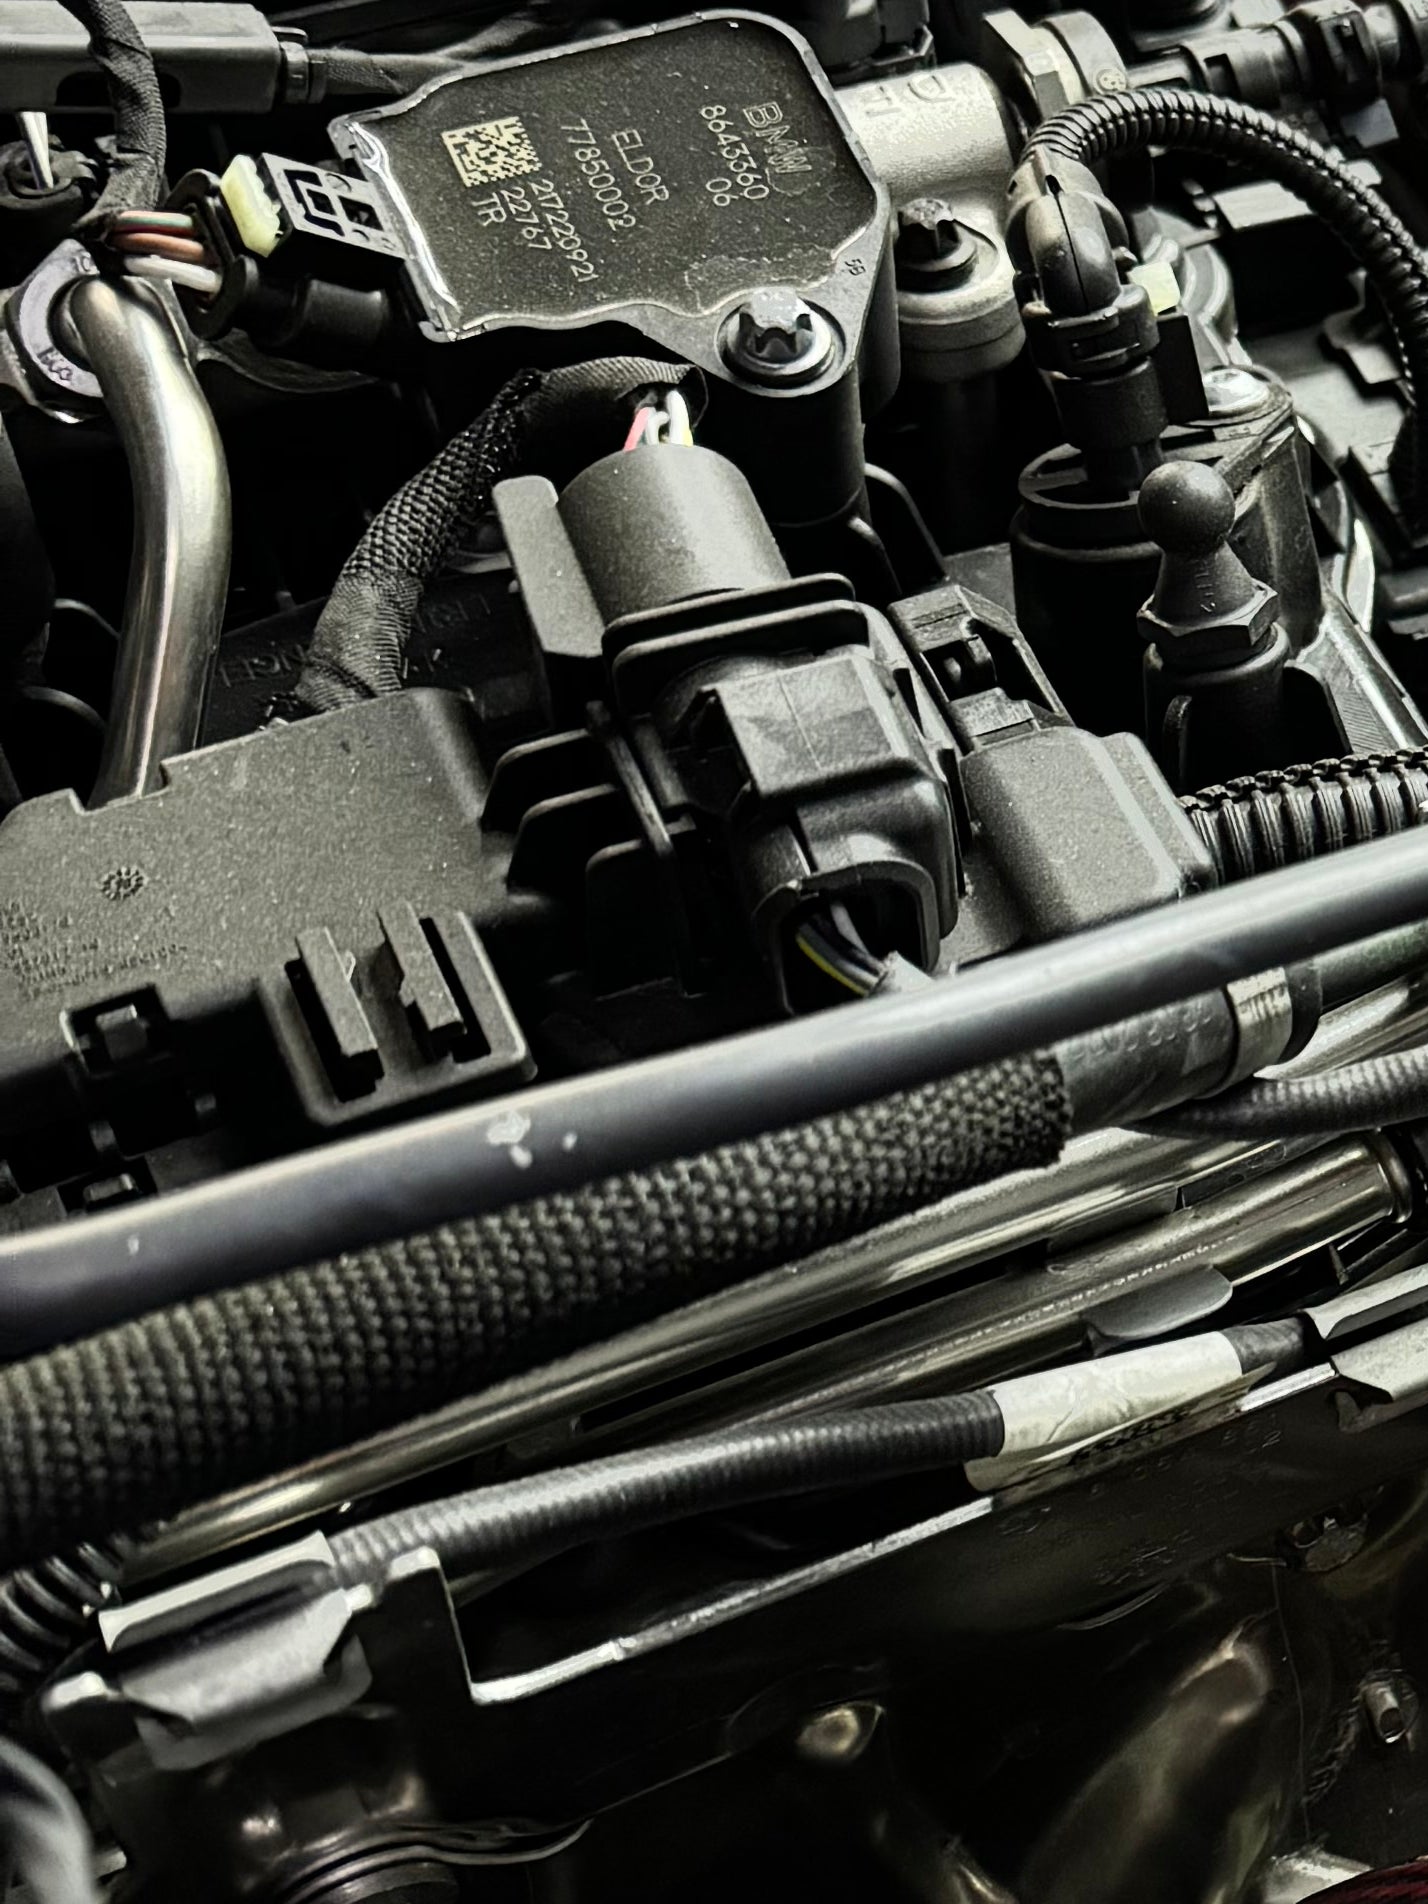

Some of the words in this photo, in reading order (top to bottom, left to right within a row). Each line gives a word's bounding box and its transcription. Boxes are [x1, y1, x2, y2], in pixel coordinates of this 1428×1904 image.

[560, 118, 637, 232] 77850002
[611, 128, 670, 205] ELDOR
[700, 103, 770, 201] 8643360
[742, 100, 813, 175] BMW
[471, 192, 507, 227] TR
[499, 185, 553, 252] 22767
[706, 176, 733, 207] 06
[530, 178, 600, 284] 217220921
